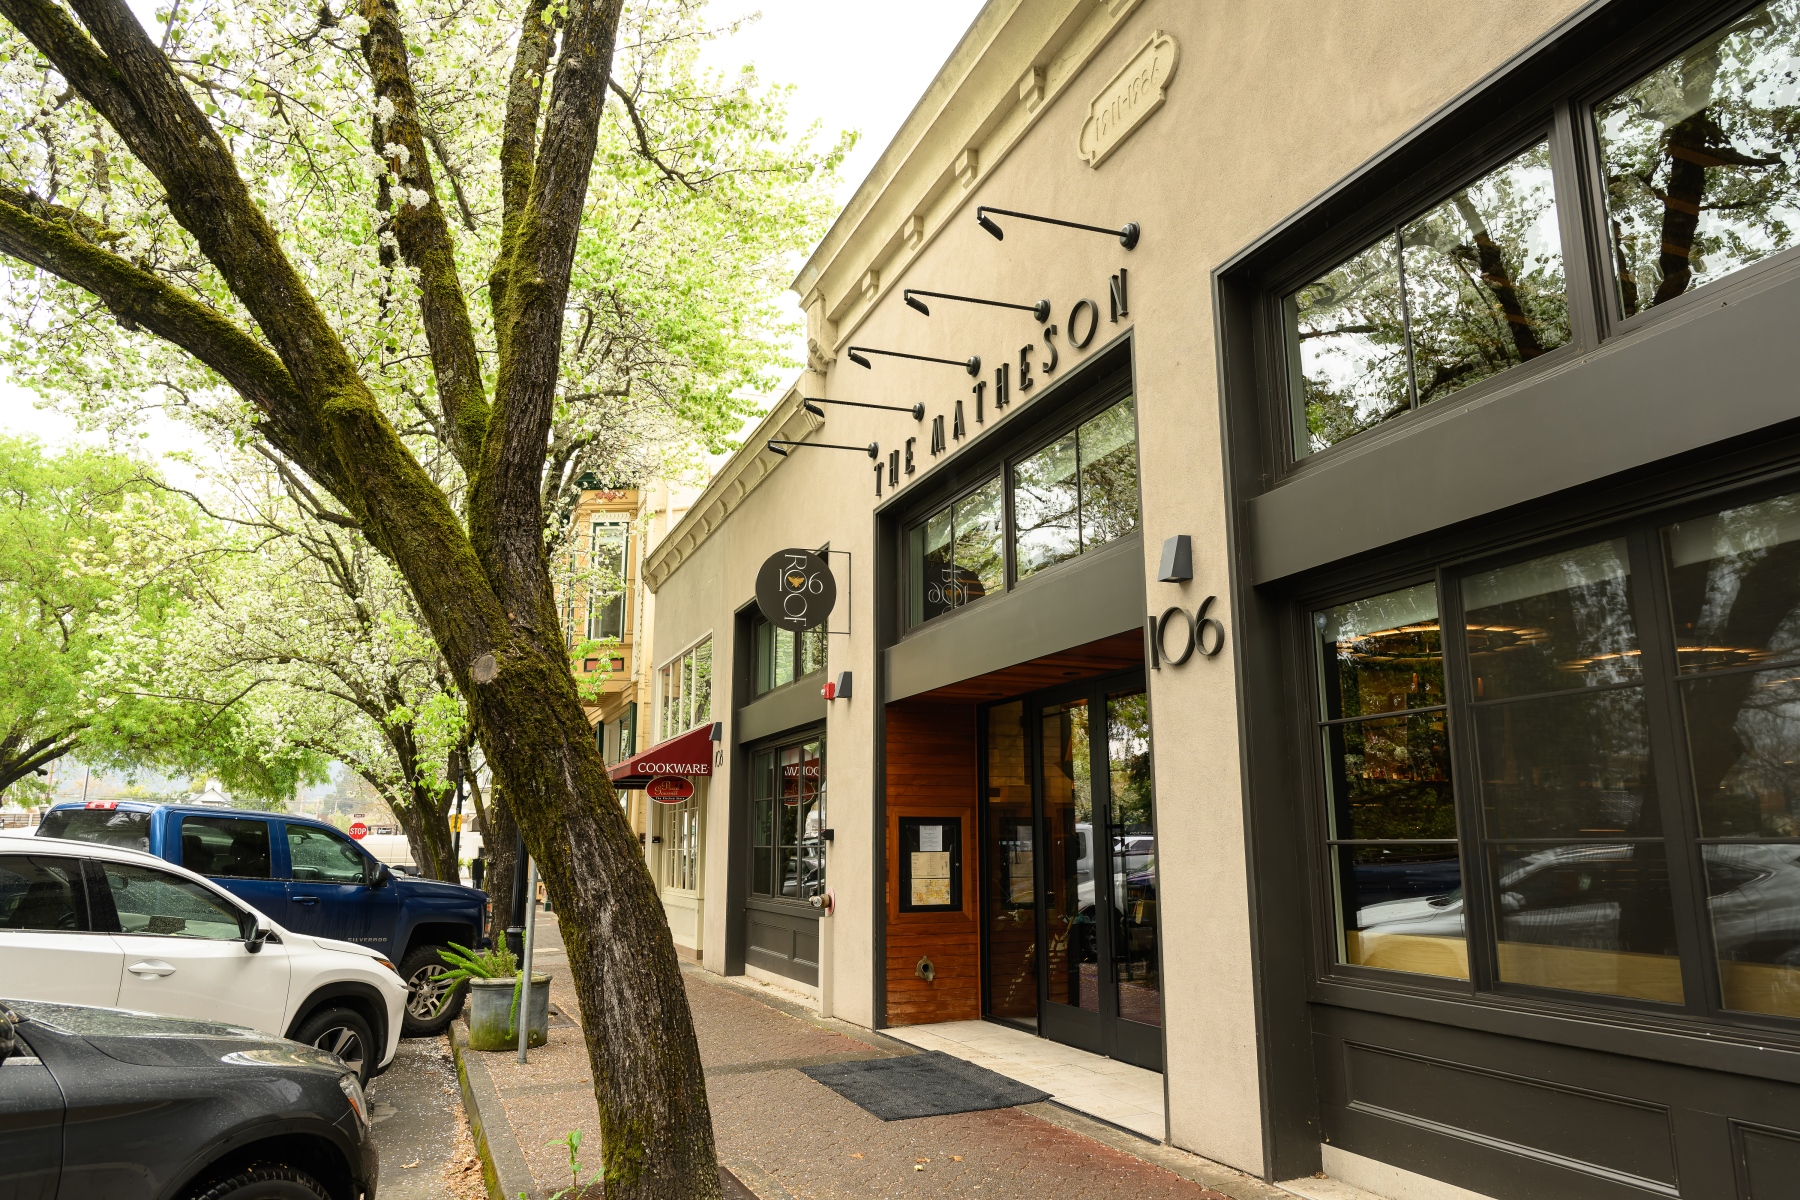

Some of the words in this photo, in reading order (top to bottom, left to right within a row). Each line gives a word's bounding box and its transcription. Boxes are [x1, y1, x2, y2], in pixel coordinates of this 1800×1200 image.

[873, 436, 917, 497] THE
[930, 267, 1129, 457] MATHESON
[778, 567, 824, 595] 106
[1147, 595, 1225, 669] 106
[637, 762, 709, 774] COOKWARE
[349, 827, 367, 835] STOP
